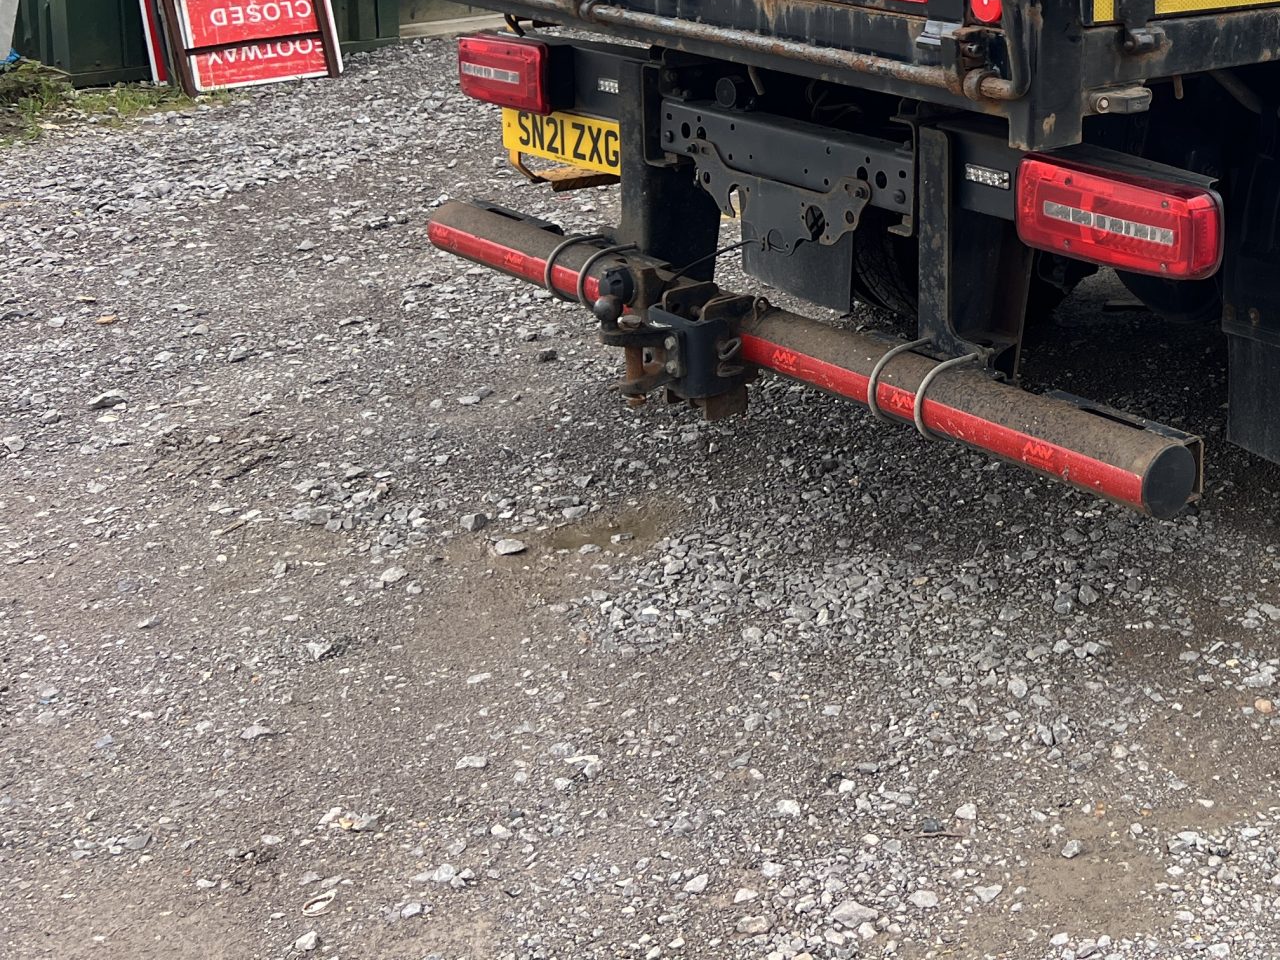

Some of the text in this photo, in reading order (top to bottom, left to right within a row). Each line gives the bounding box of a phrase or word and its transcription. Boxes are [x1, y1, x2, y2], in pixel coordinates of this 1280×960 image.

[209, 0, 312, 26] CLOSED
[518, 111, 619, 167] SN21 ZXG
